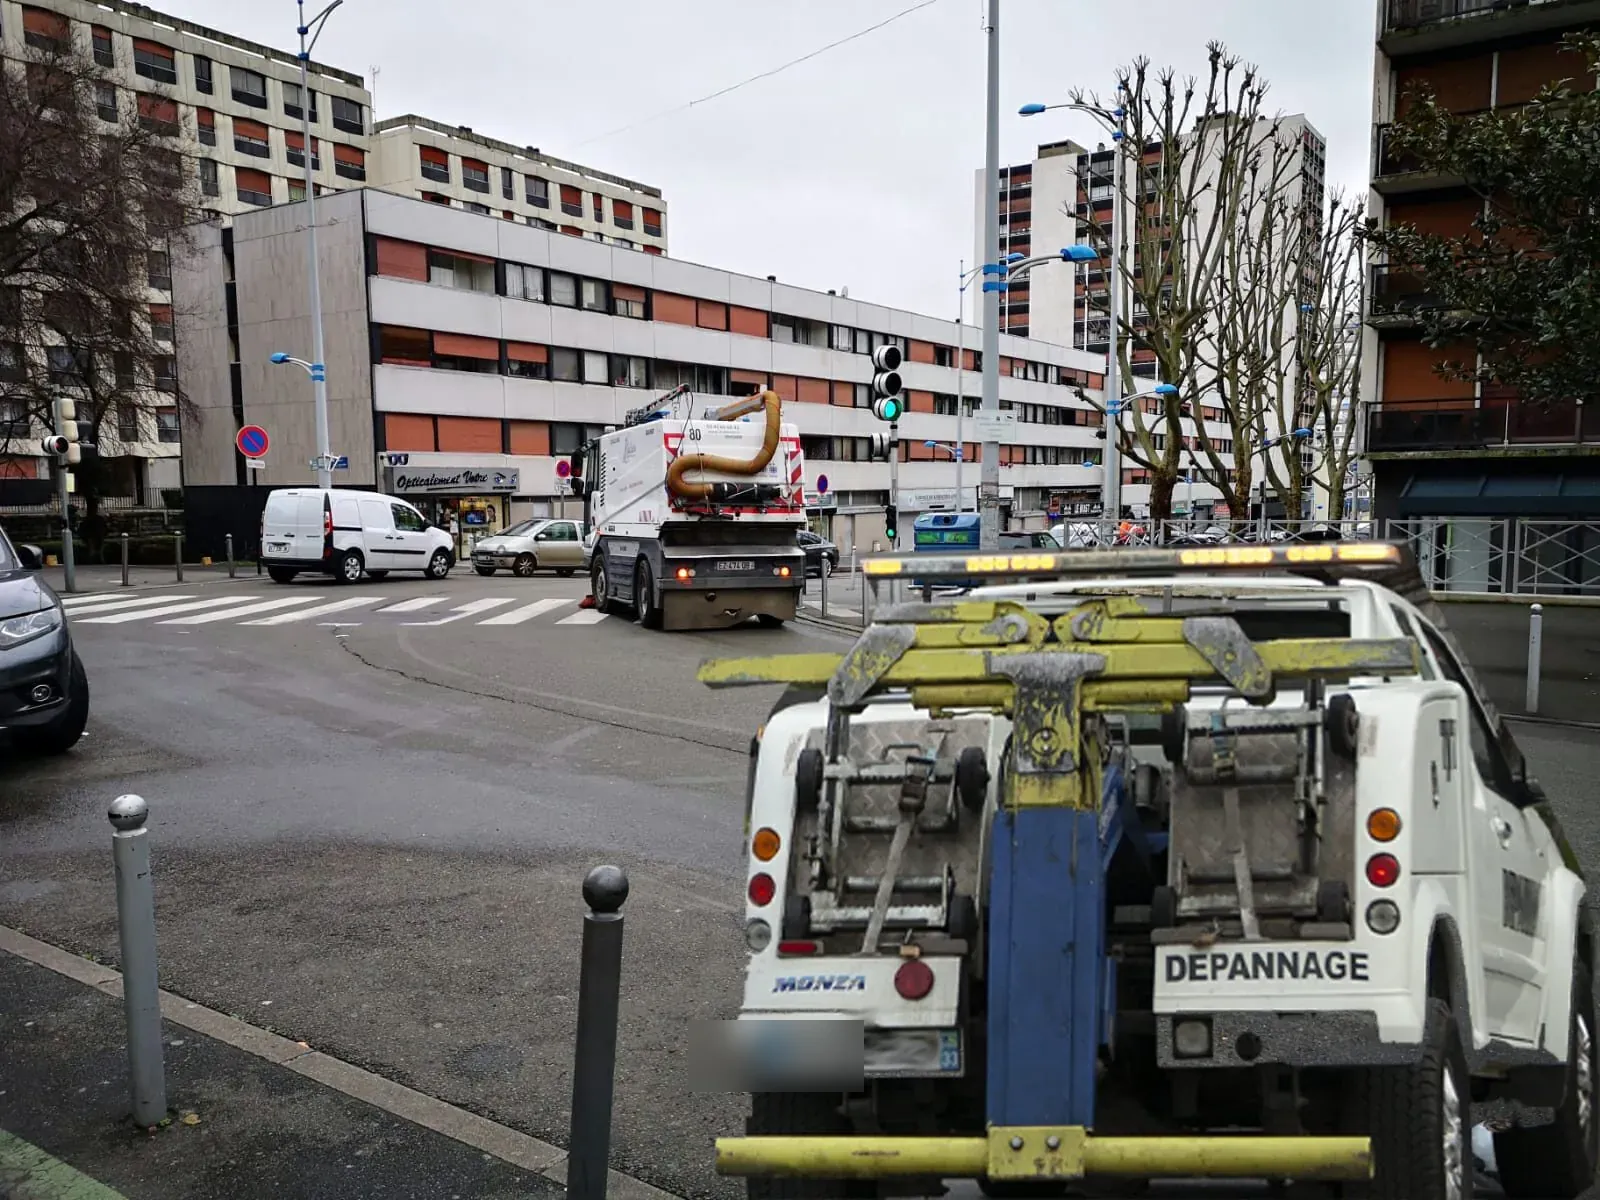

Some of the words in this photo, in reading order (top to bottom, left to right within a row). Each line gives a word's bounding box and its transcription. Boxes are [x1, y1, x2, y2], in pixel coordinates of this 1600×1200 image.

[689, 428, 701, 441] 80
[397, 473, 461, 491] Opticalement
[463, 470, 488, 483] Votre
[1165, 951, 1370, 983] DEPANNAGE
[772, 975, 866, 993] MONZA
